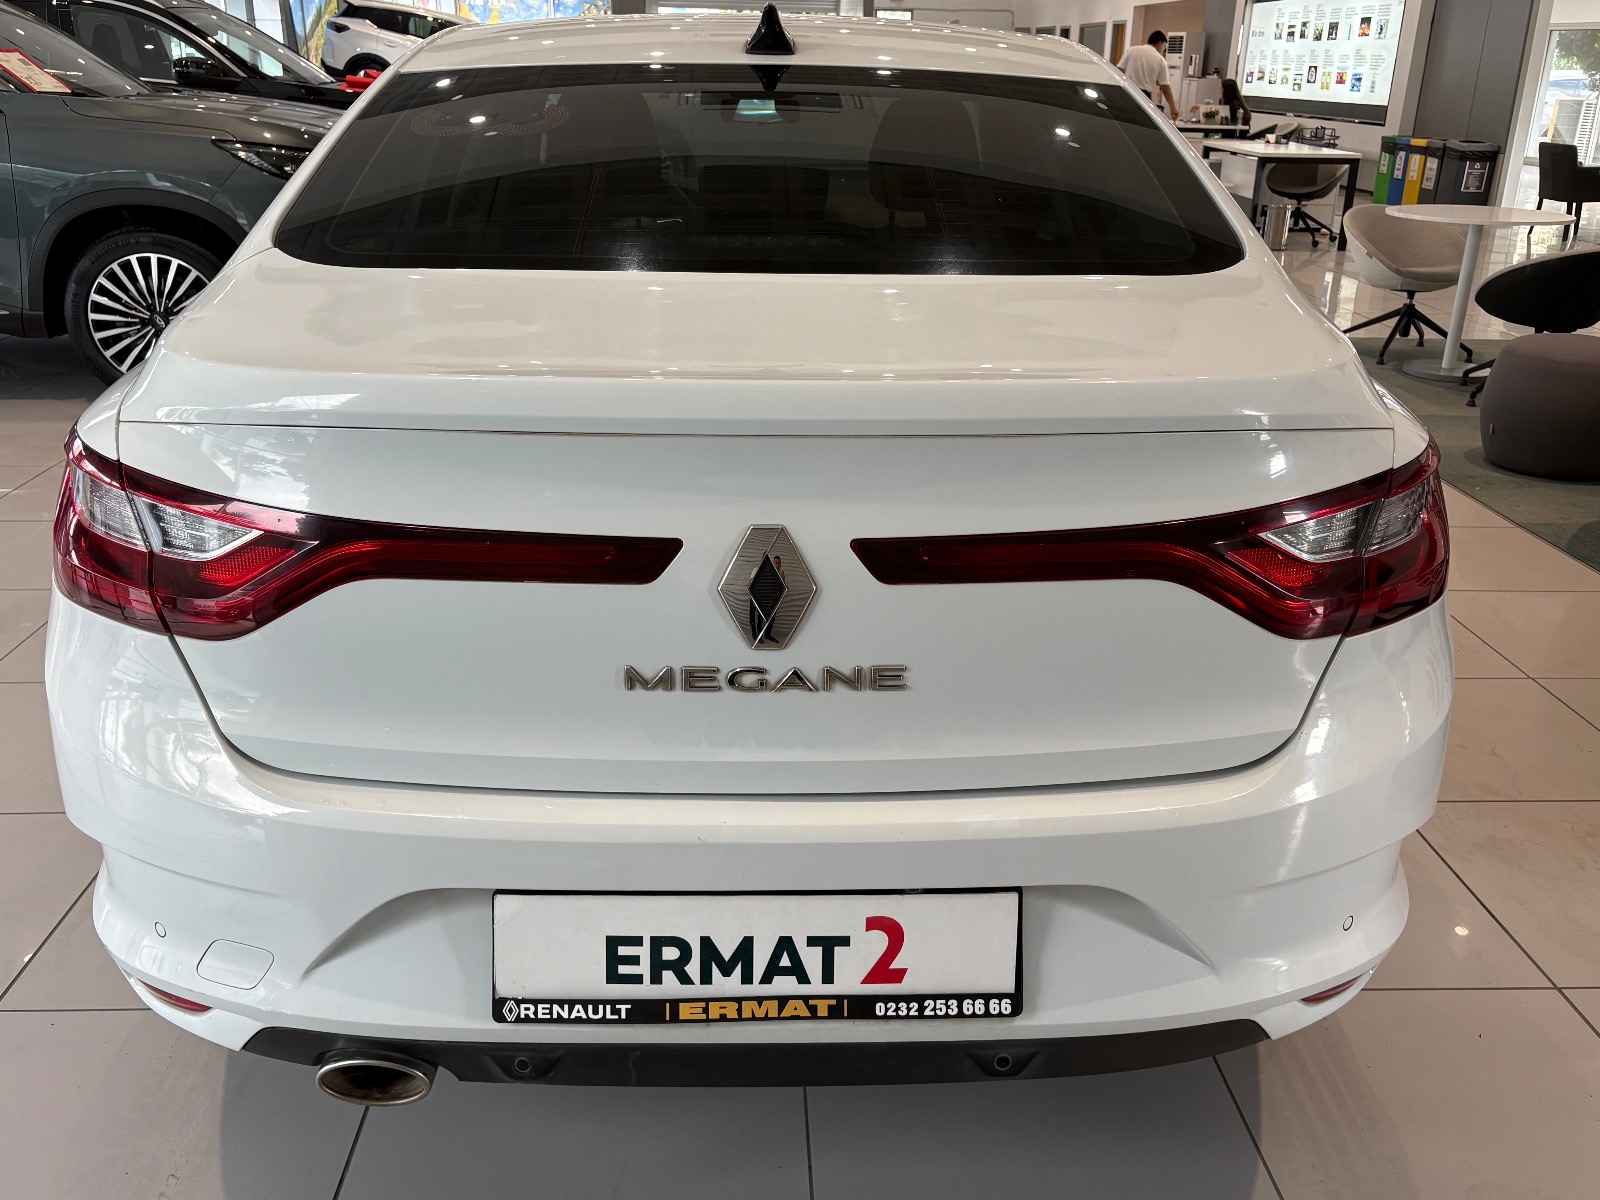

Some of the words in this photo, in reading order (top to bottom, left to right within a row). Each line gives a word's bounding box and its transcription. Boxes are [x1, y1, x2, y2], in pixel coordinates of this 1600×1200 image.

[623, 664, 908, 693] MEGANE
[605, 935, 851, 986] ERMAT
[859, 915, 909, 985] 2
[519, 1003, 632, 1020] RENAULT
[678, 998, 837, 1020] ERMAT
[875, 1002, 919, 1016] 0232
[923, 999, 959, 1016] 253
[962, 998, 985, 1015] 66
[988, 998, 1012, 1015] 66
